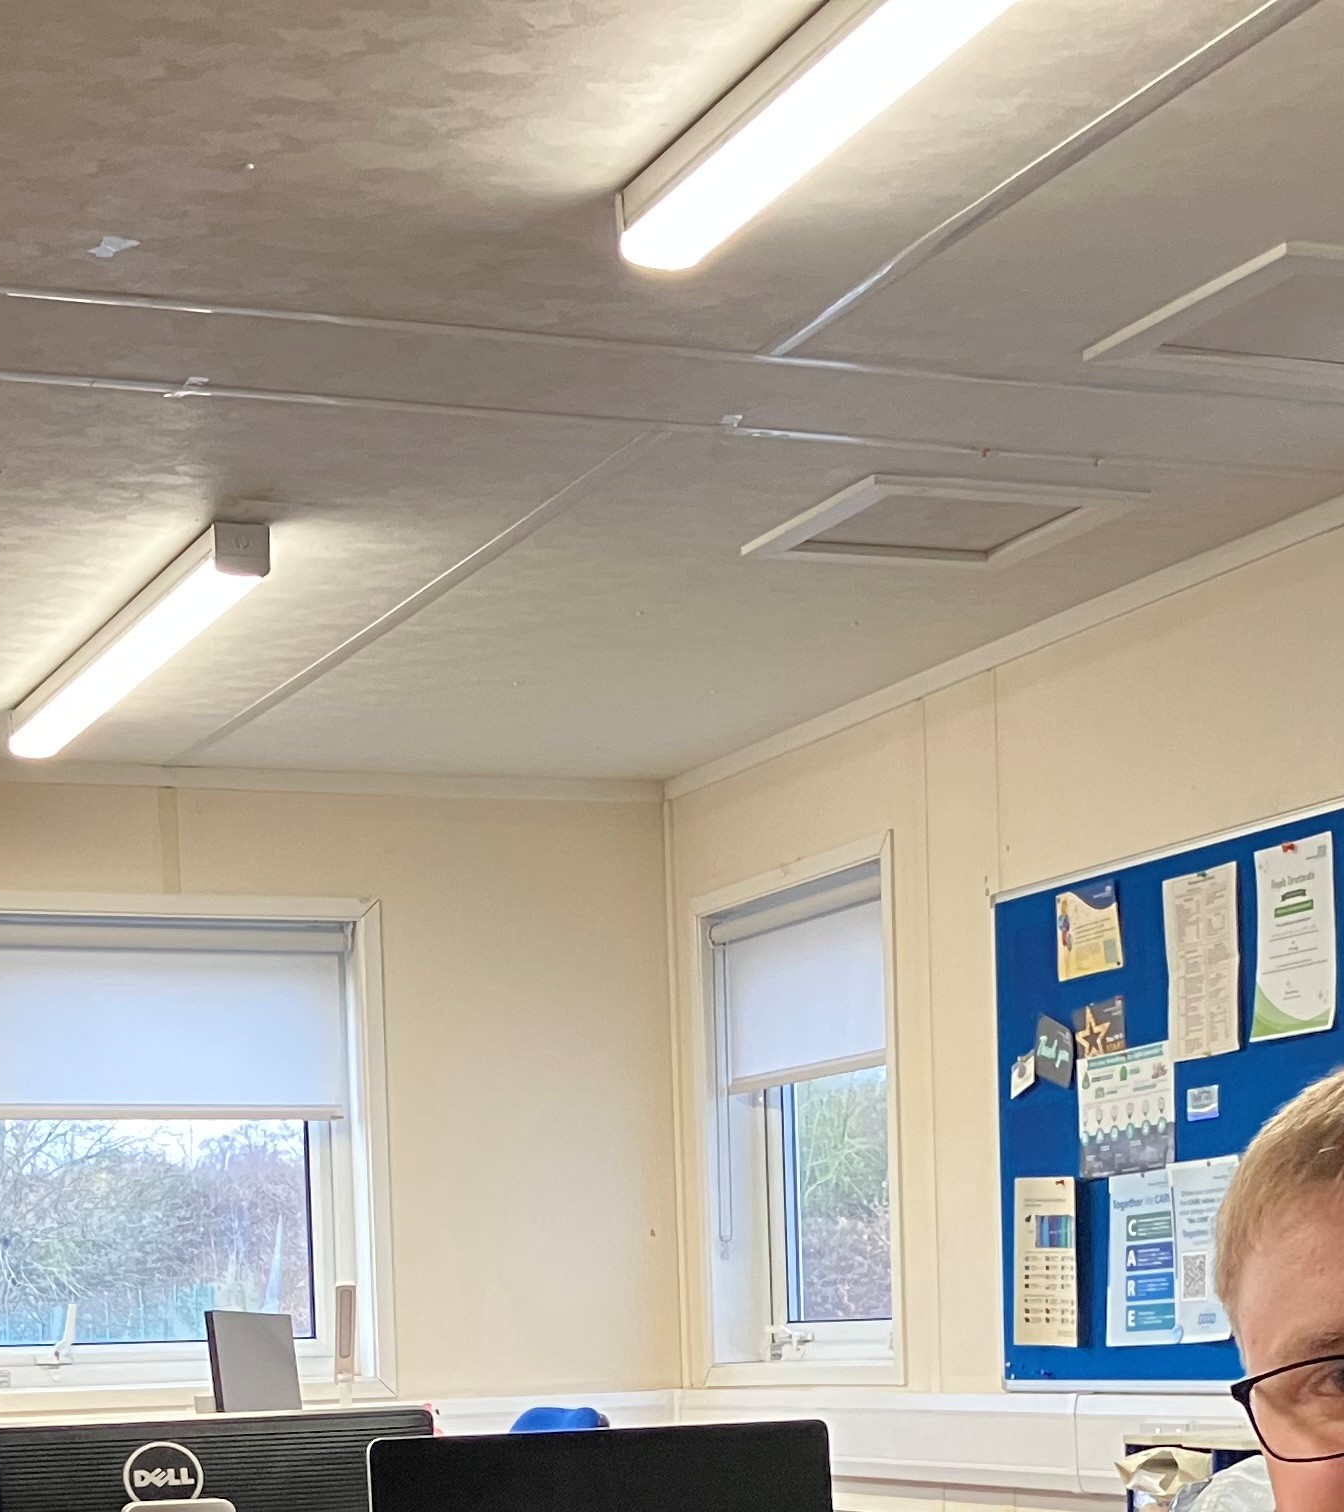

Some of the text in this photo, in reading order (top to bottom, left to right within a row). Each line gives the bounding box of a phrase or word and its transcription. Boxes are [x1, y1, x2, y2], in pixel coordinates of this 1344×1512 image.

[1128, 1219, 1137, 1236] C
[1127, 1250, 1137, 1267] A
[1127, 1280, 1136, 1297] R
[1127, 1310, 1136, 1327] E
[133, 1467, 195, 1488] DELL
